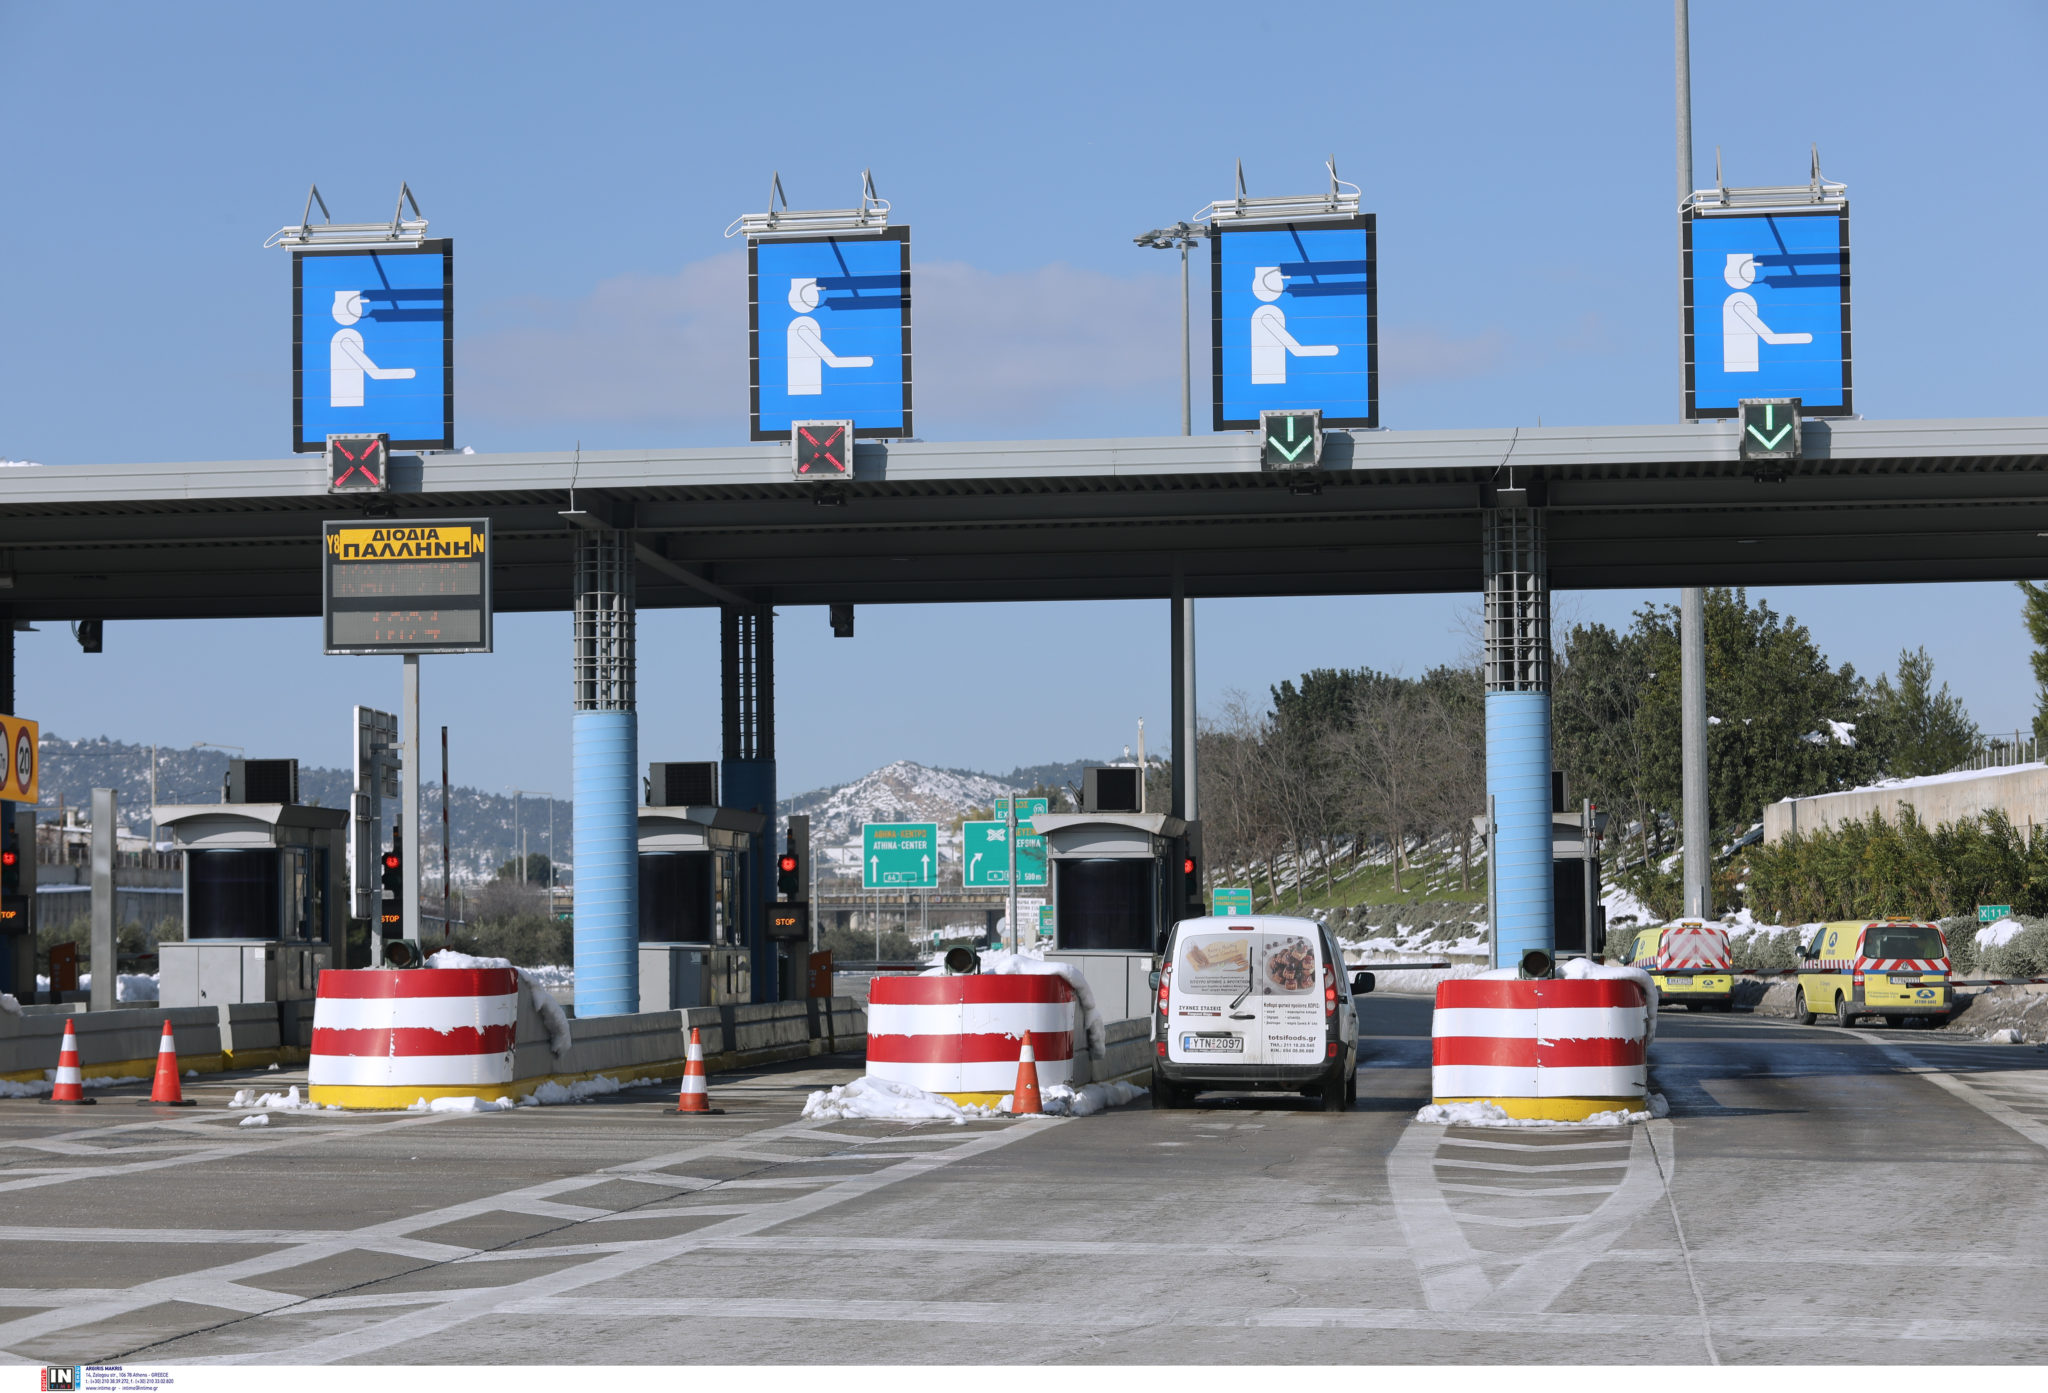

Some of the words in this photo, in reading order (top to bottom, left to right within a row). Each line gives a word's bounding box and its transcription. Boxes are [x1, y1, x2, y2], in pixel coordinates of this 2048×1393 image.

[372, 529, 440, 542] ΔΙΟΔΙΑ
[343, 542, 470, 558] ΠΑΛΛΗΝΗ
[19, 746, 30, 775] 20
[1, 911, 16, 919] TOP
[776, 918, 796, 926] STOP
